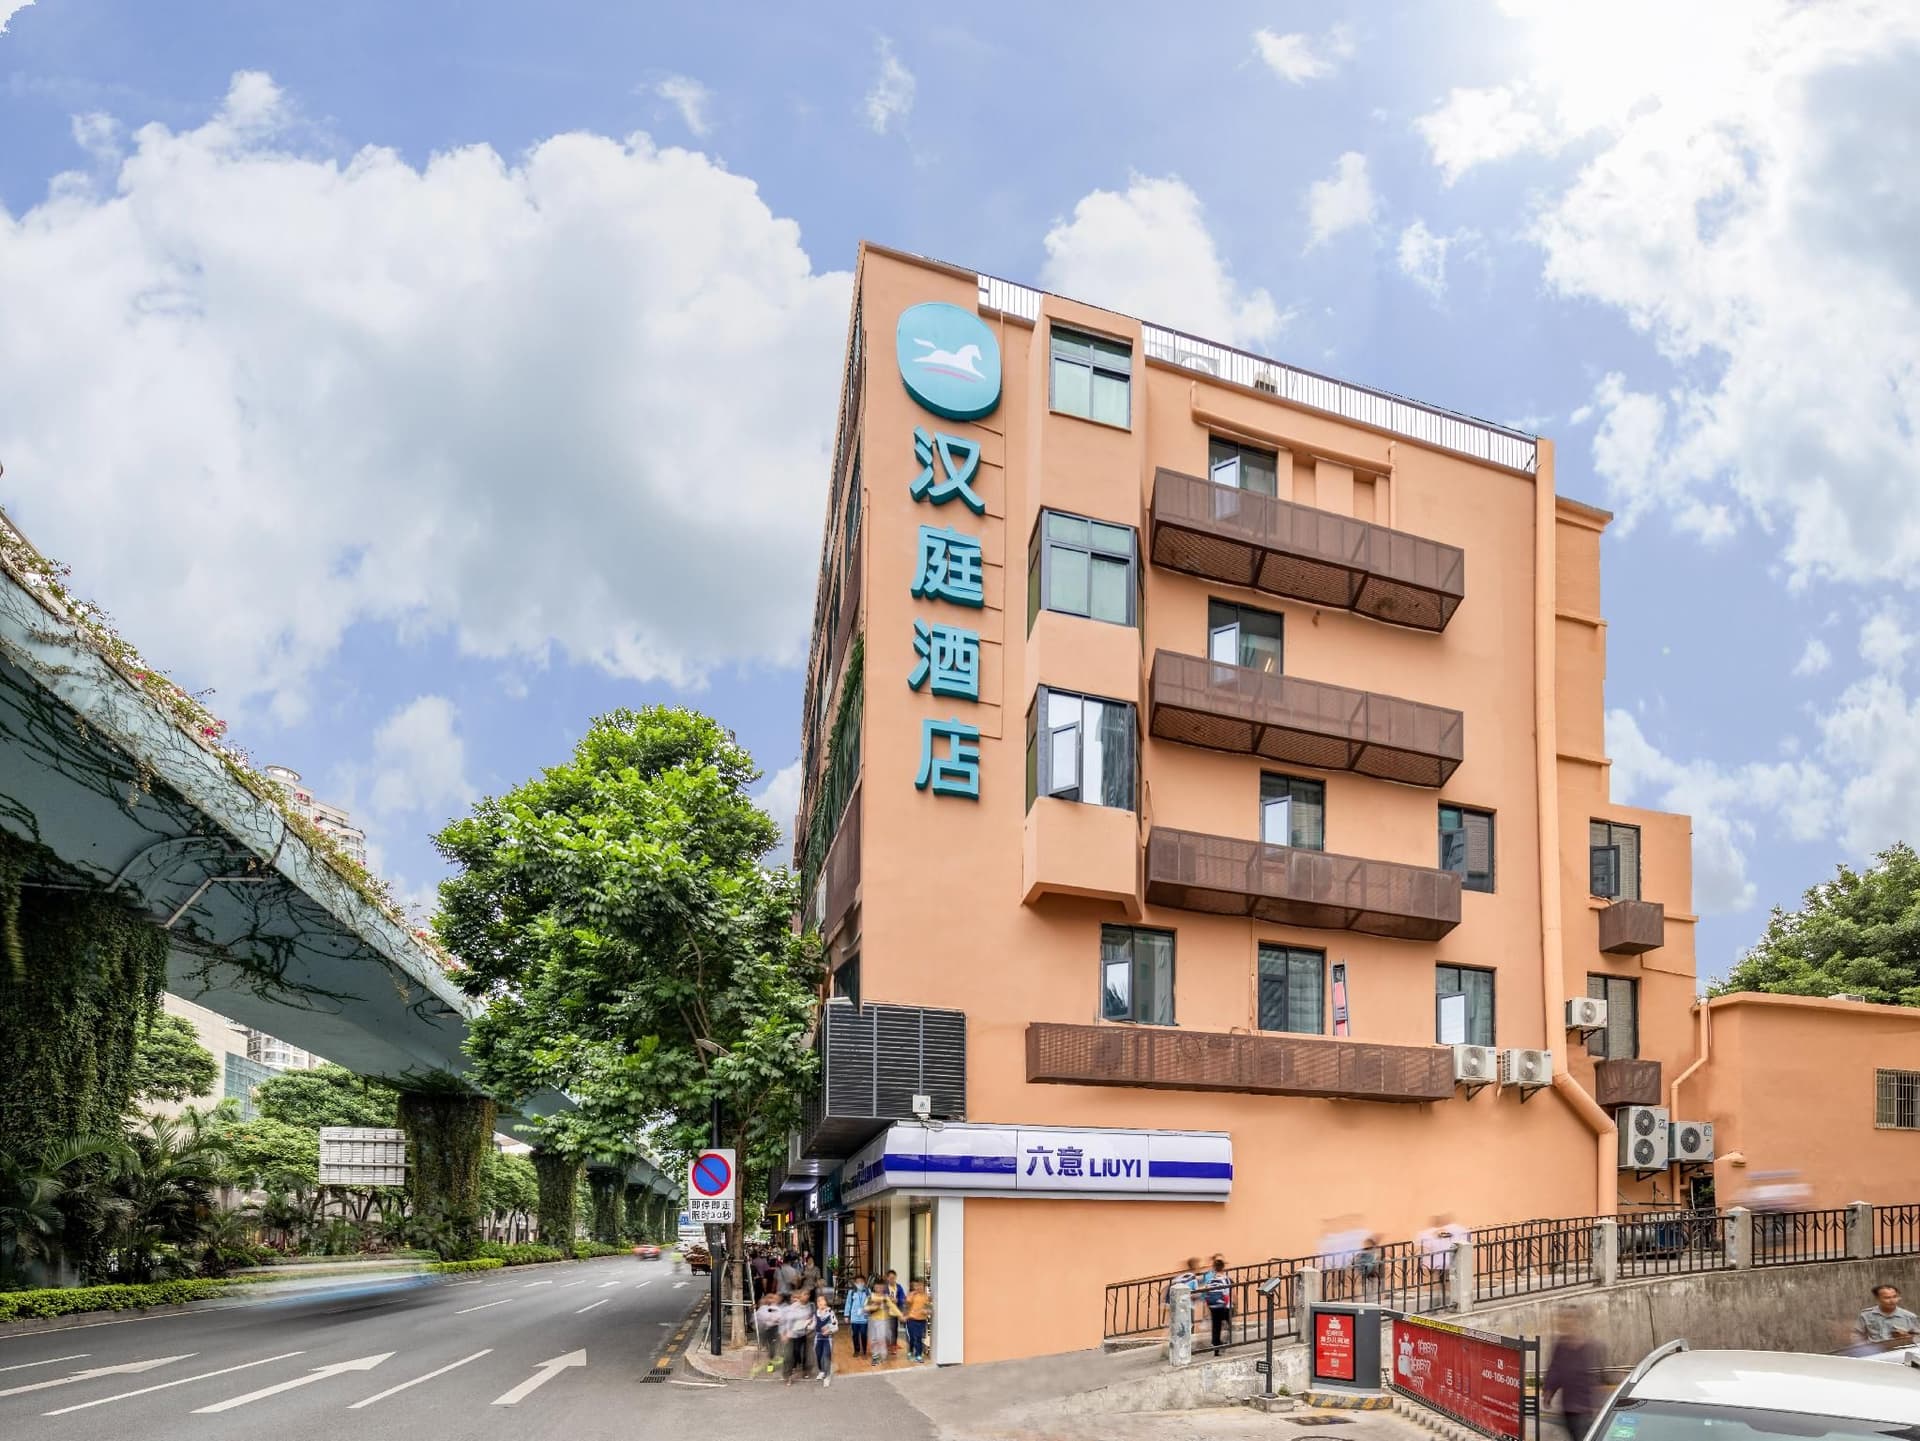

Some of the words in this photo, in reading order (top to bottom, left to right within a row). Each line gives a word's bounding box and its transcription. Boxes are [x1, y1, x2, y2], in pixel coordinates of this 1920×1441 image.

[908, 425, 986, 801] 汉庭酒店
[1026, 1145, 1084, 1177] 六意
[1089, 1158, 1141, 1178] LIUYI
[691, 1200, 731, 1210] 即停即走
